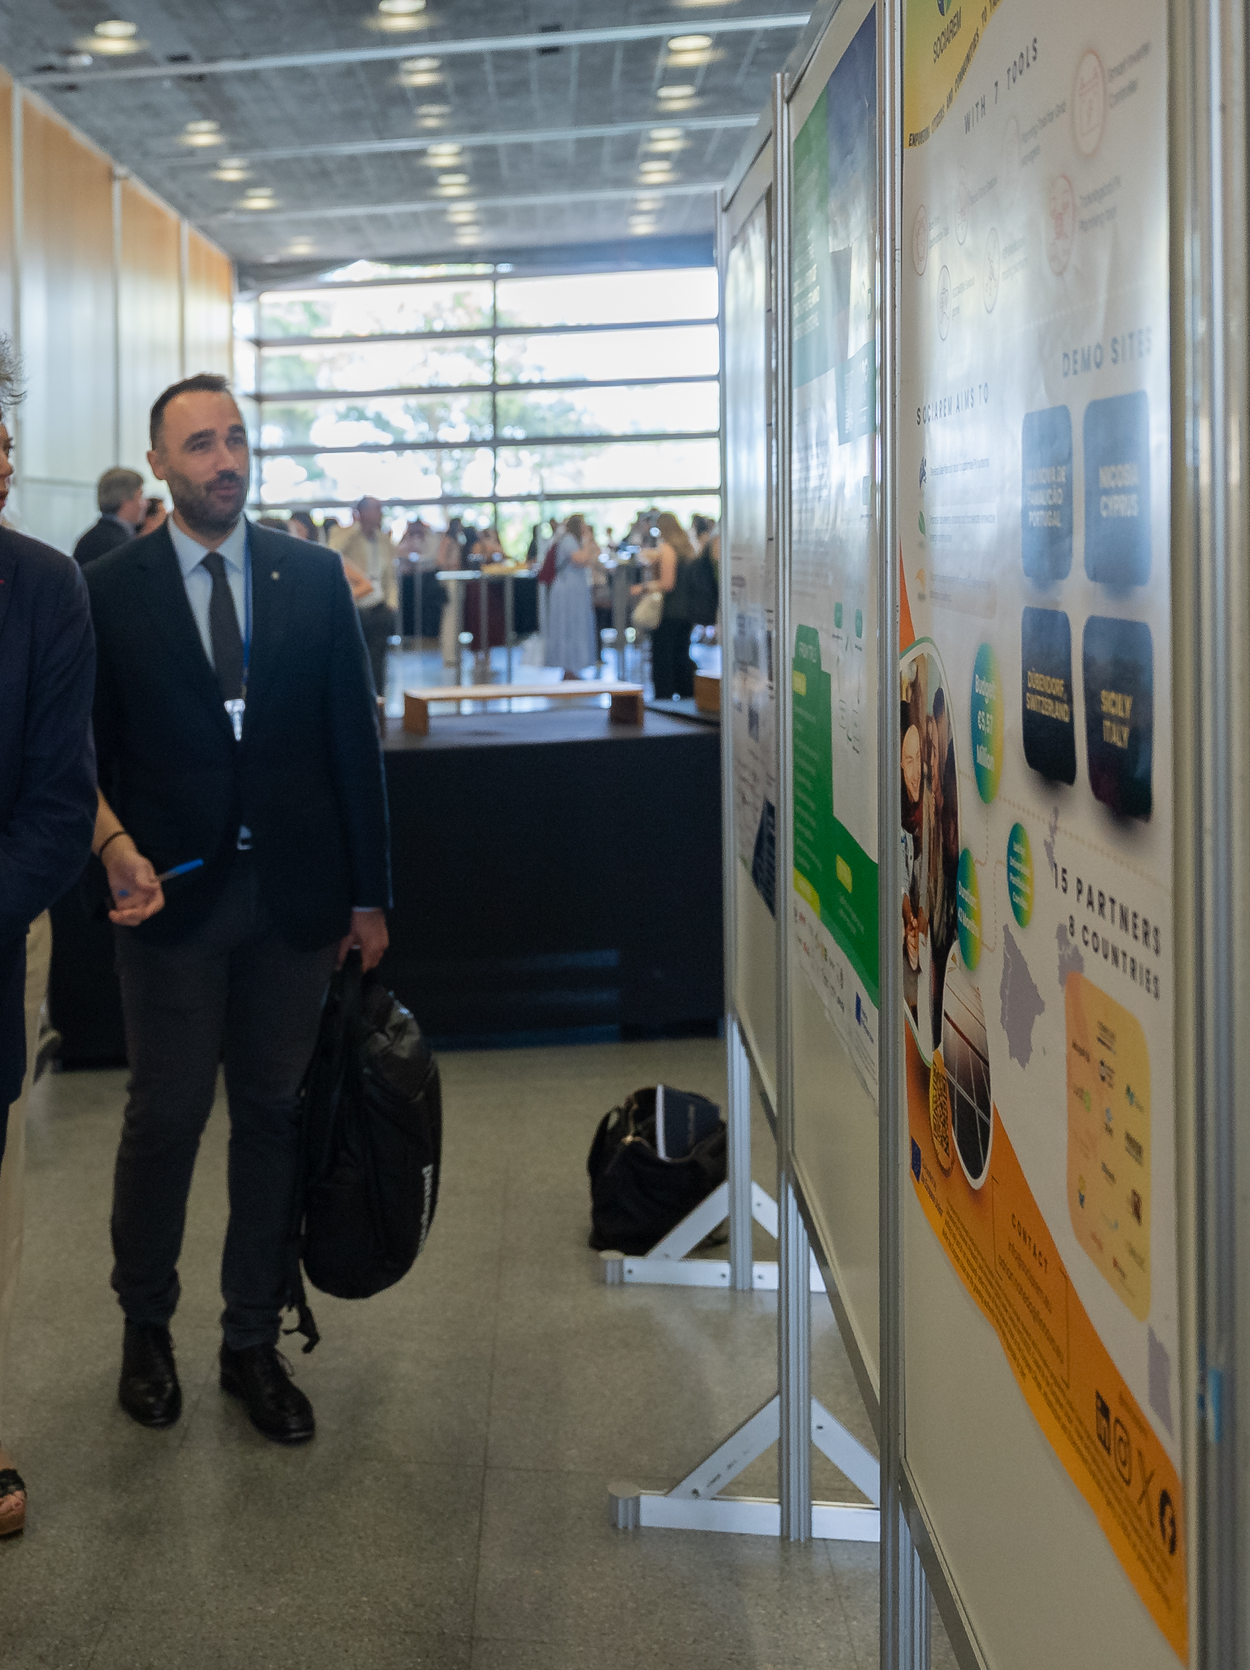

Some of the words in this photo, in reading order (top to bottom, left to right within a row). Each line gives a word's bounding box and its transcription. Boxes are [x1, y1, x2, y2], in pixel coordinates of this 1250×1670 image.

[964, 94, 986, 135] WITH
[994, 80, 999, 105] 7
[1007, 36, 1038, 90] TOOLS
[1062, 347, 1104, 378] DEMO
[1110, 328, 1153, 366] SITES
[916, 395, 953, 427] SOCIAREM
[955, 387, 975, 413] AIMS
[978, 381, 989, 406] TO
[1025, 692, 1071, 724] SWITZERLAND
[1102, 719, 1130, 750] ITALY
[1053, 862, 1068, 894] 15
[1075, 876, 1162, 956] PARTNERS
[1068, 914, 1076, 938] 8
[1081, 924, 1161, 1000] COUNTRIES
[1011, 1212, 1049, 1275] CONTACT
